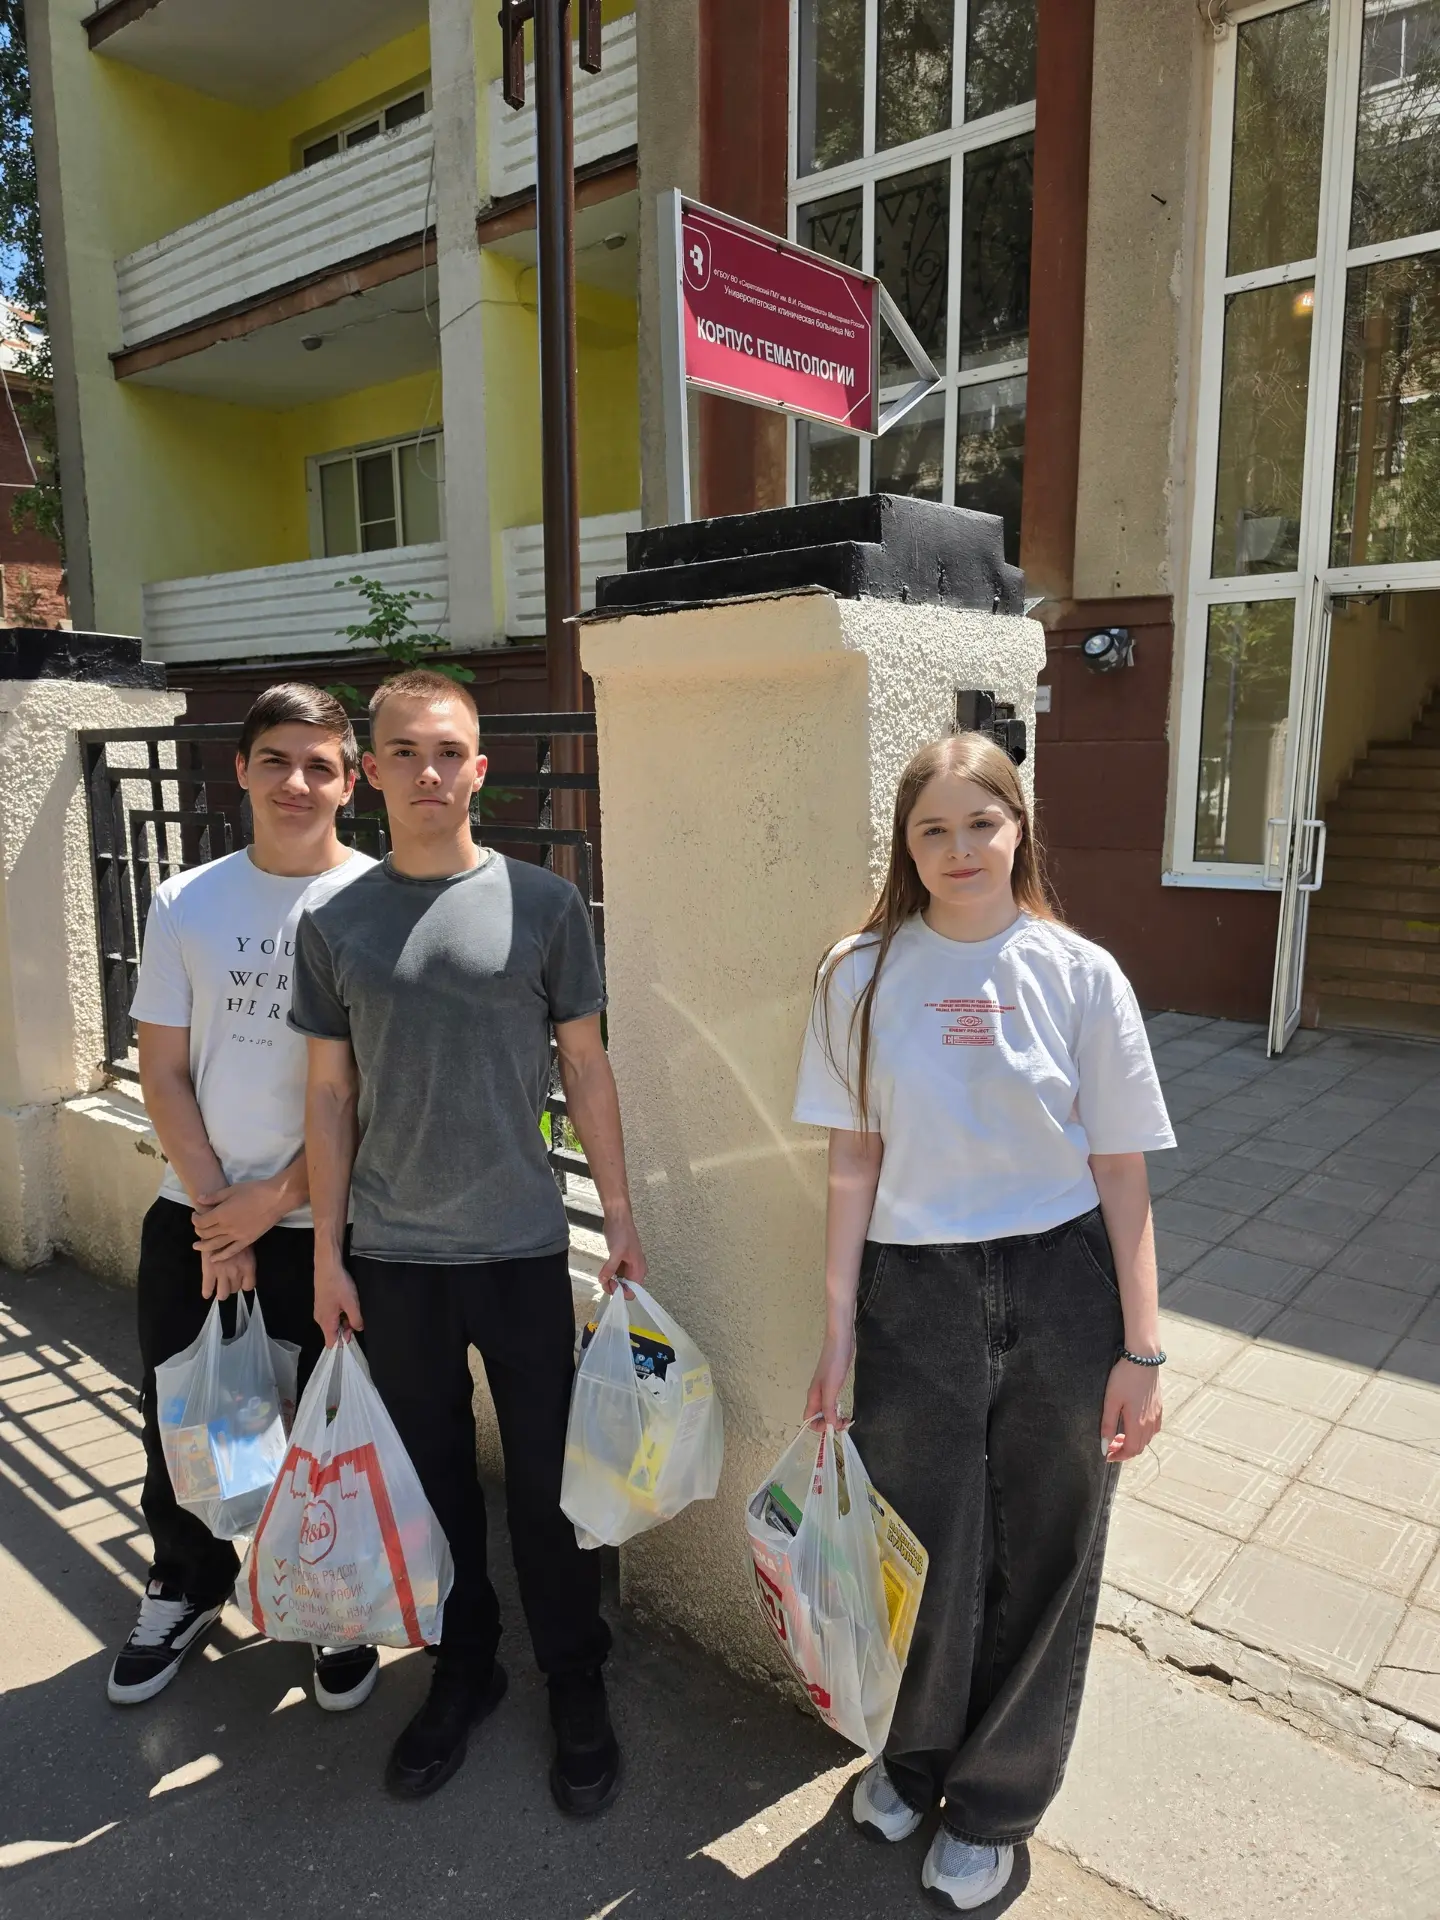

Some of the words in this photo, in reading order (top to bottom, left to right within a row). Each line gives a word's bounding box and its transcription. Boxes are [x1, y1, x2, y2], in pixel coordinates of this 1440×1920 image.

[713, 269, 730, 280] ФГБОУ
[730, 275, 738, 284] ВО
[724, 284, 777, 312] Университетская
[777, 306, 815, 326] клиническая
[815, 318, 844, 336] больница
[844, 327, 855, 339] №3
[696, 316, 754, 356] КОРПУС
[756, 337, 855, 387] ГЕМАТОЛОГИИ
[255, 1038, 273, 1047] JPG
[322, 1562, 358, 1582] РЯДОМ
